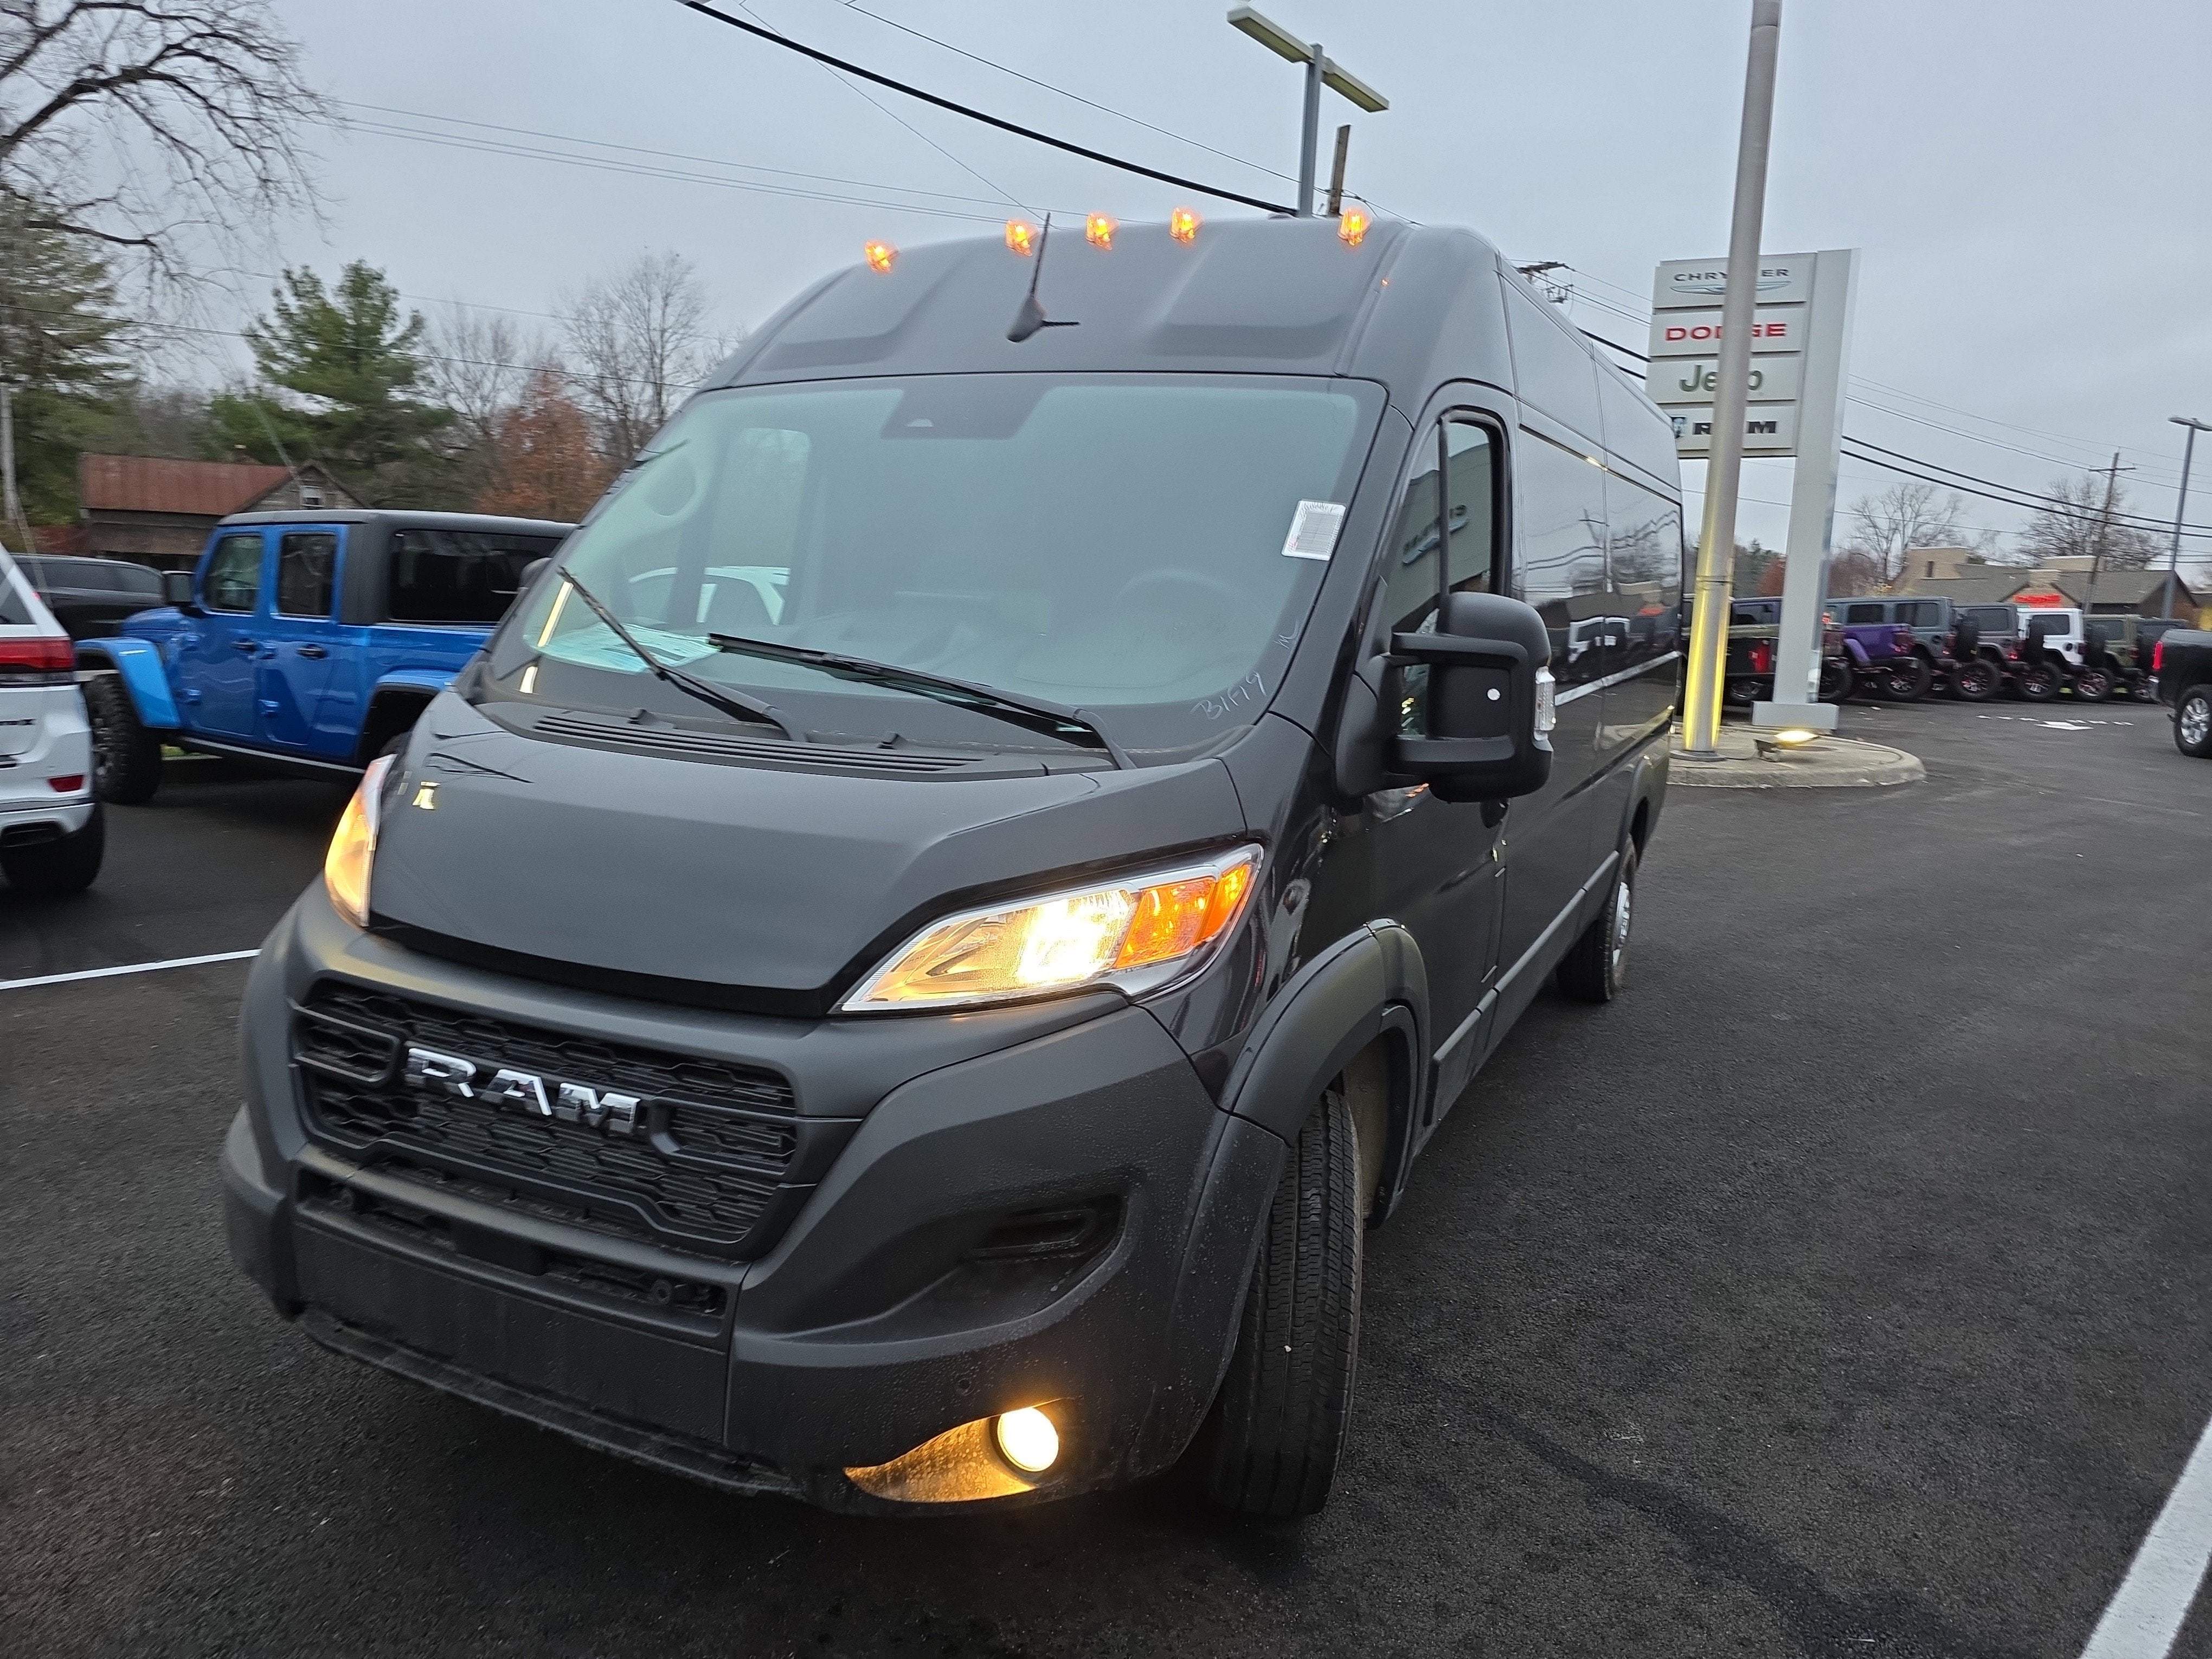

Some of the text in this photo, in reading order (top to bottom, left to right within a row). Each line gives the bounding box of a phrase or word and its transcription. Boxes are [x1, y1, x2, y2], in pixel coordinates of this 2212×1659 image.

[1674, 268, 1790, 281] CHRYER
[1694, 421, 1777, 435] RM
[403, 1047, 642, 1134] RAM
